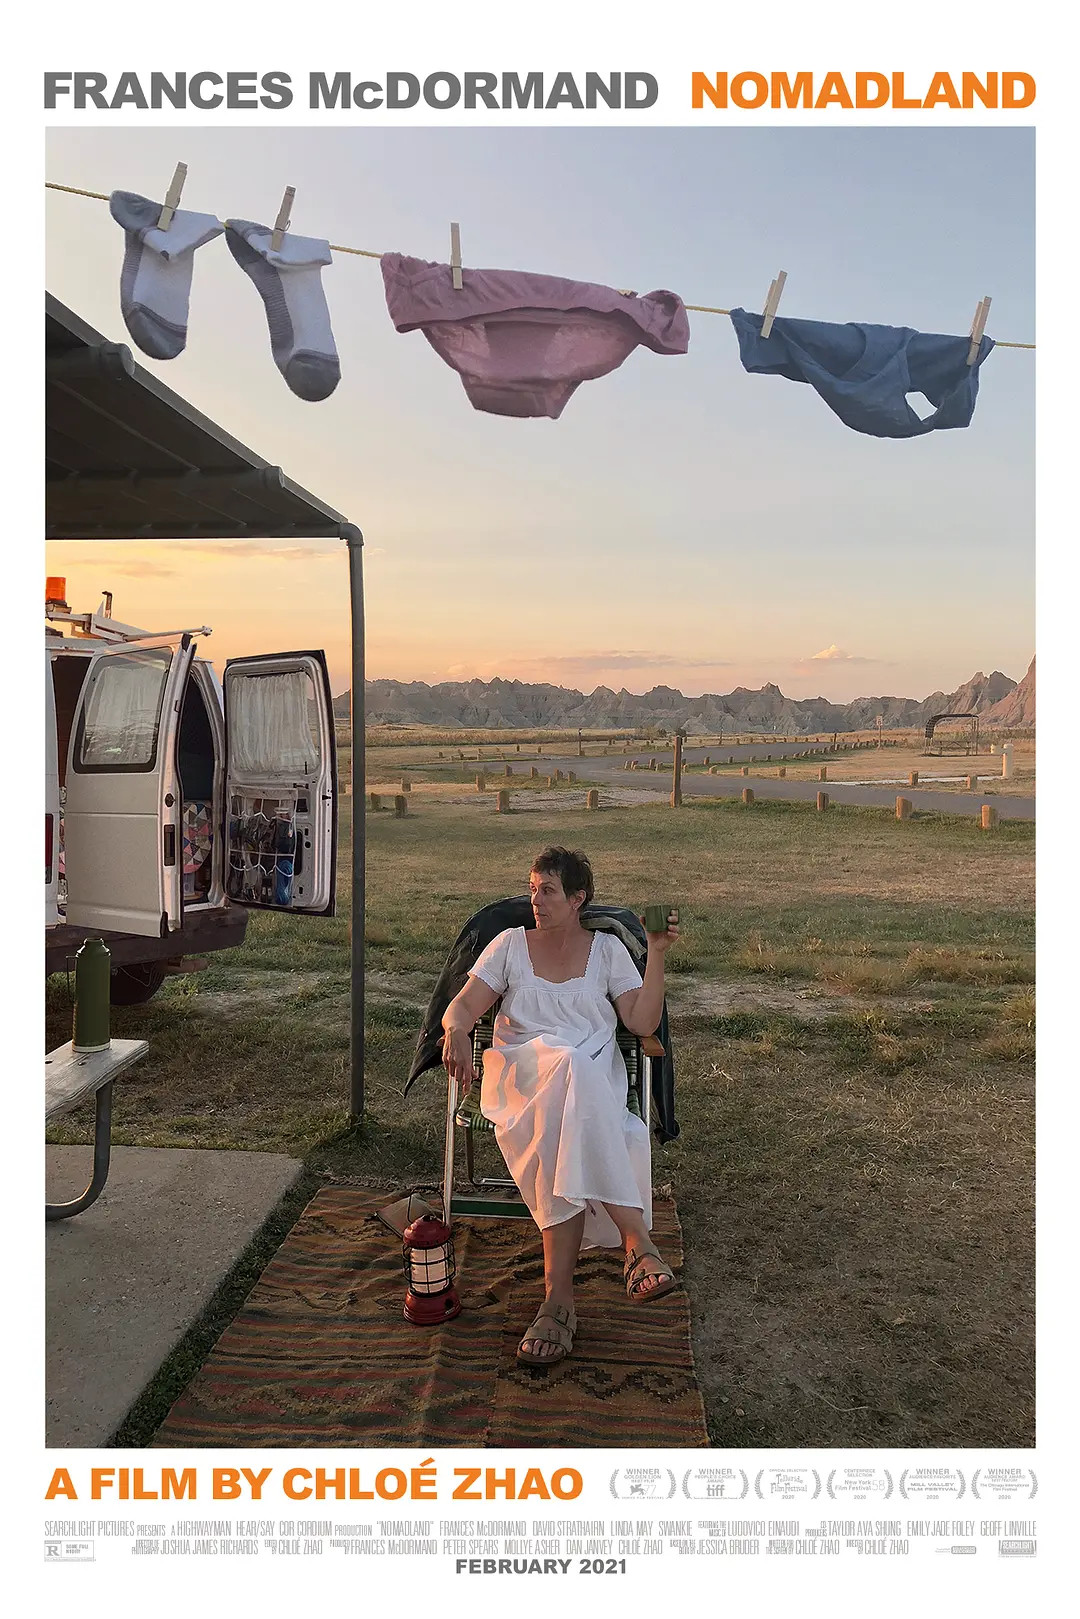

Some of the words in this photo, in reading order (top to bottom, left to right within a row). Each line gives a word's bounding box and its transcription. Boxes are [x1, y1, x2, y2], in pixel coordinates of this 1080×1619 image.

[44, 72, 293, 109] FRANCES
[310, 72, 658, 109] McDORMAND
[692, 71, 1036, 109] NOMADLAND
[45, 1468, 78, 1500] A
[91, 1468, 197, 1500] FILM
[213, 1468, 272, 1500] BY
[283, 1457, 437, 1500] CHLOÉ
[452, 1468, 583, 1500] ZHAO
[706, 1484, 725, 1496] tiff
[45, 1521, 96, 1536] SEARCHLIGHT
[98, 1521, 134, 1536] PICTURES
[137, 1525, 165, 1536] PRESENTS
[177, 1521, 231, 1536] HIGHWAYMAN
[237, 1520, 275, 1537] HEAR/SAY
[280, 1521, 294, 1536] COR
[297, 1521, 332, 1536] CORDIUM
[335, 1525, 372, 1536] PRODUCTION
[440, 1521, 474, 1536] FRANCES
[477, 1521, 526, 1536] McDORMAND
[533, 1521, 554, 1536] DAVID
[557, 1521, 604, 1536] STRATHAIRN
[611, 1521, 633, 1536] LINDA
[636, 1521, 652, 1536] MAY
[659, 1521, 692, 1536] SWANKIE
[728, 1521, 765, 1536] LUDOVICO
[768, 1521, 800, 1536] EINAUDI
[828, 1521, 855, 1536] TAYLOR
[857, 1521, 874, 1536] AVA
[876, 1521, 901, 1536] SHUNG
[907, 1521, 930, 1536] EMILY
[930, 1521, 950, 1536] JADE
[952, 1521, 975, 1536] FOLEY
[980, 1521, 1002, 1536] GEOFF
[1004, 1521, 1037, 1536] LINVILLE
[46, 1546, 59, 1556] R
[161, 1540, 190, 1554] JOSHUA
[193, 1540, 217, 1554] JAMES
[220, 1540, 259, 1554] RICHARDS
[279, 1537, 301, 1554] CHLOÉ
[303, 1540, 322, 1554] ZHAO
[351, 1540, 385, 1554] FRANCES
[388, 1540, 437, 1554] McDORMAND
[443, 1540, 466, 1554] PETER
[469, 1540, 498, 1554] SPEARS
[505, 1540, 532, 1554] MOLLYE
[535, 1540, 560, 1554] ASHER
[567, 1540, 582, 1554] DAN
[584, 1540, 613, 1554] JANVEY
[619, 1537, 641, 1554] CHLOÉ
[643, 1540, 662, 1554] ZHAO
[697, 1540, 727, 1554] JESSICA
[730, 1540, 759, 1554] BRUDER
[796, 1537, 818, 1554] CHLOÉ
[820, 1540, 839, 1554] ZHAO
[865, 1537, 887, 1554] CHLOÉ
[890, 1540, 909, 1554] ZHAO
[456, 1559, 572, 1574] FEBRUARY
[580, 1559, 625, 1574] 2021
